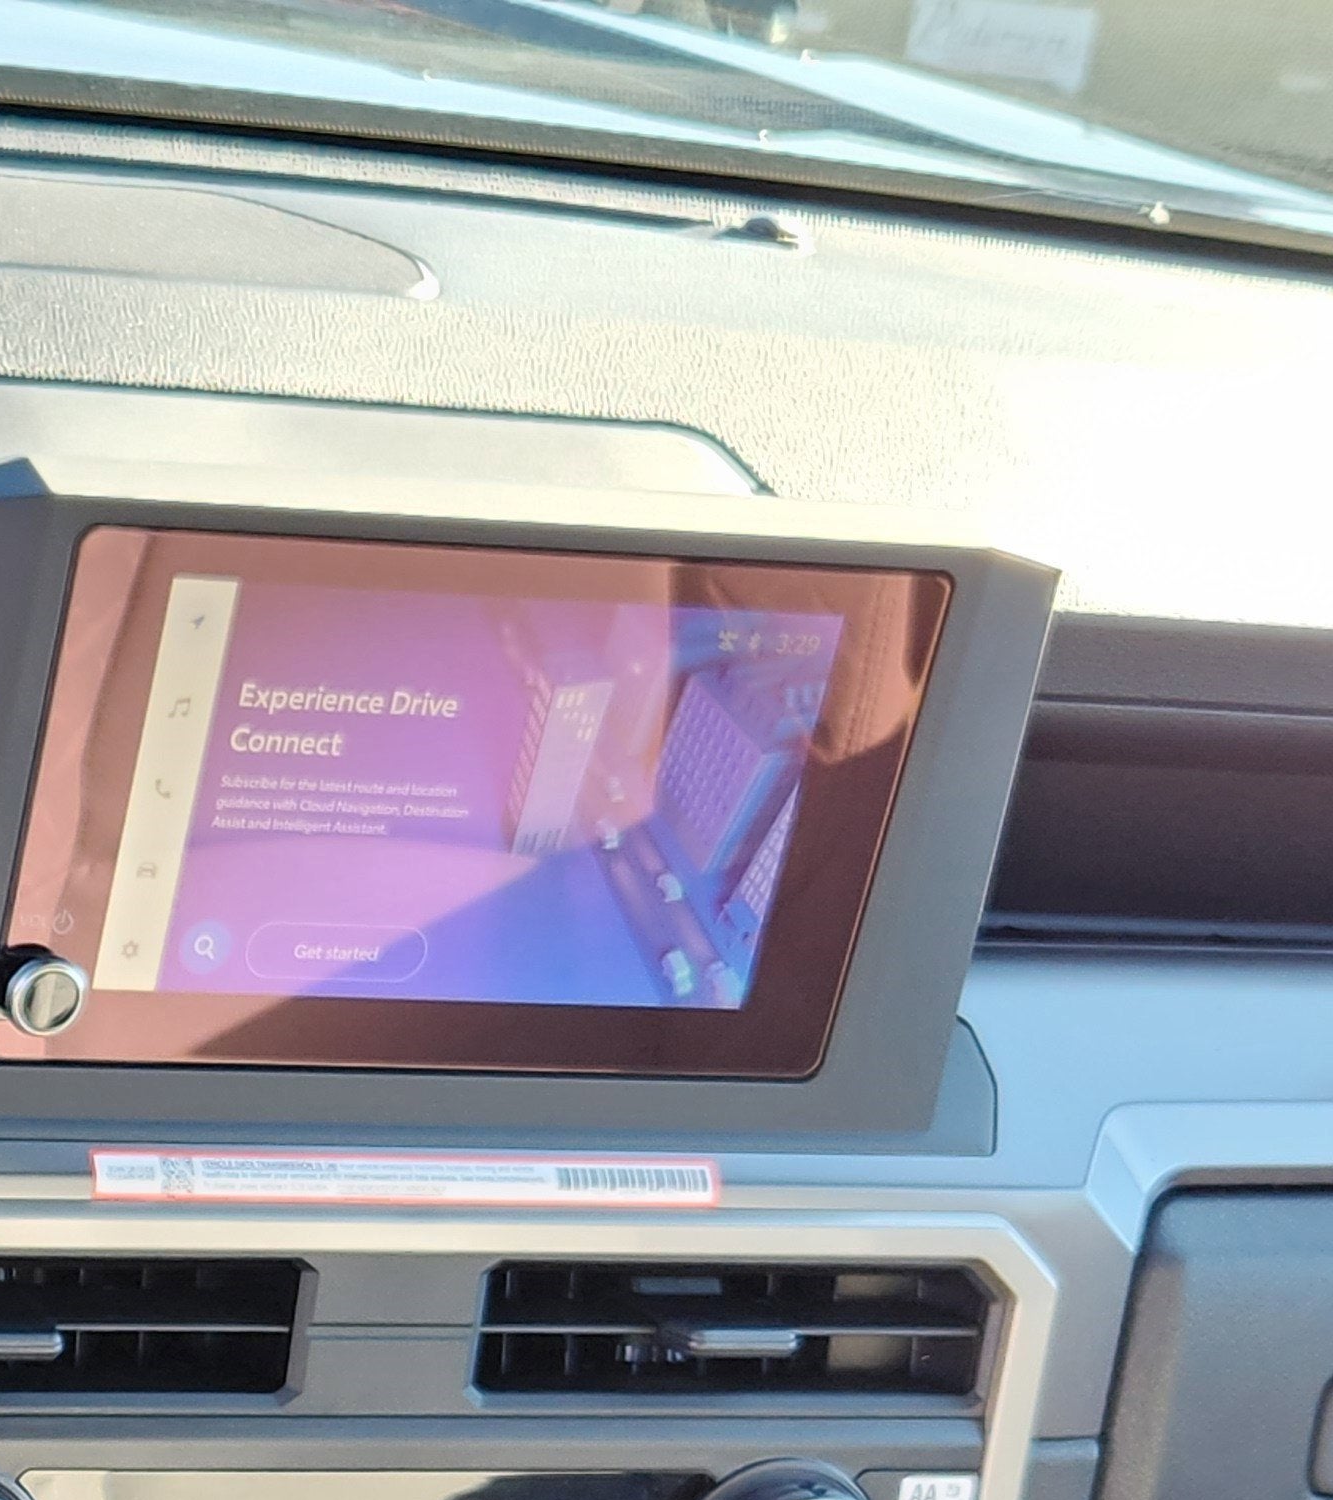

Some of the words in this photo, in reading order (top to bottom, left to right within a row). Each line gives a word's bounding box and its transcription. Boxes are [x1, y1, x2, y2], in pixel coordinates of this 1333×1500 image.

[775, 633, 822, 656] 3:29
[238, 683, 385, 715] Experience
[390, 691, 459, 718] Drive
[230, 726, 343, 757] Connect
[220, 775, 278, 791] Subscribe
[280, 777, 296, 791] for
[298, 779, 316, 792] the
[319, 779, 352, 793] latest
[354, 783, 384, 796] route
[385, 783, 409, 796] and
[411, 784, 458, 798] location
[216, 797, 270, 811] guidance
[273, 798, 297, 811] with
[300, 798, 334, 812] Cloud
[403, 804, 469, 819] Destination
[211, 815, 246, 829] Assist
[248, 817, 271, 830] and
[294, 943, 322, 961] Get
[325, 945, 380, 963] started
